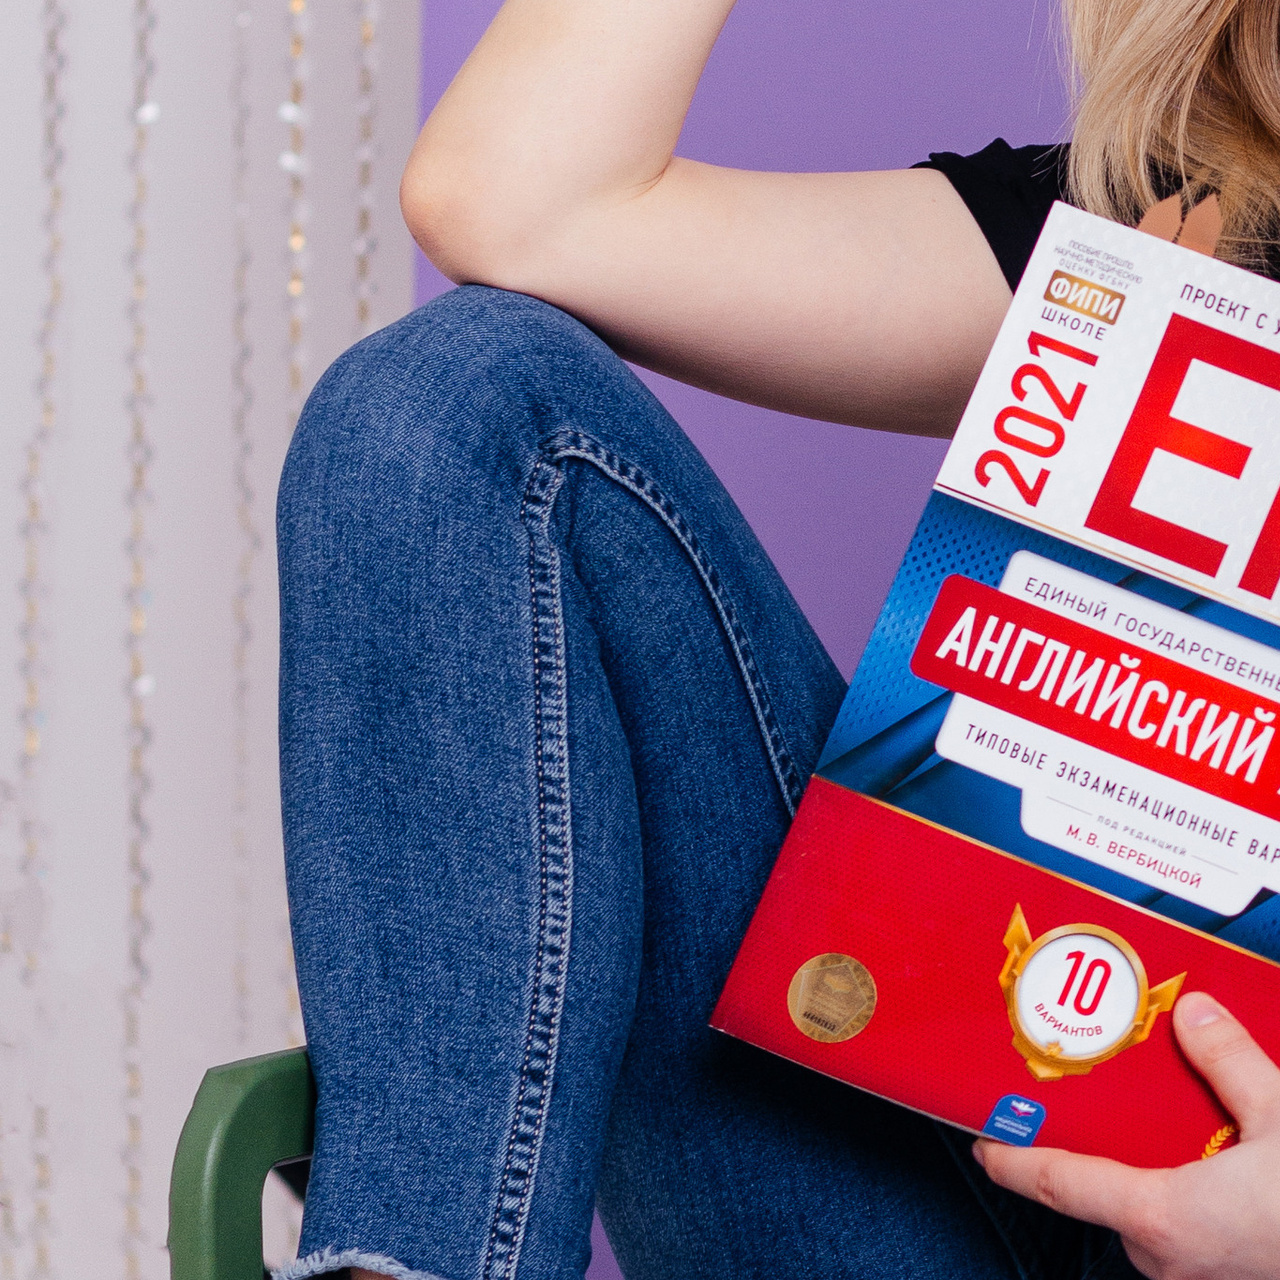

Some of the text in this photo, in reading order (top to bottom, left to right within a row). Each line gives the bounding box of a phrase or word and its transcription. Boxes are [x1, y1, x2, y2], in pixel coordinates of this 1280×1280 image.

[1041, 306, 1107, 341] ШКОЛЕ
[1050, 277, 1121, 321] ФИПИ
[1180, 283, 1251, 322] ПРОЕКТ
[1256, 313, 1268, 330] С
[974, 331, 1100, 507] 2021
[1024, 577, 1108, 633] ЕДИНЫЙ
[935, 606, 1276, 785] АНГЛИЙСКИЙ
[964, 724, 1048, 771] ТИПОВЫЕ
[1056, 761, 1238, 849] ЭКЗАМЕНАЦИОННЫЕ
[1066, 824, 1202, 889] М. В. ВЕРБИЦКОЙ
[1097, 815, 1187, 856] ПОД РЕДАКЦИЕЙ
[1057, 950, 1112, 1016] 10
[1035, 1003, 1103, 1037] ВАРИАНТОВ
